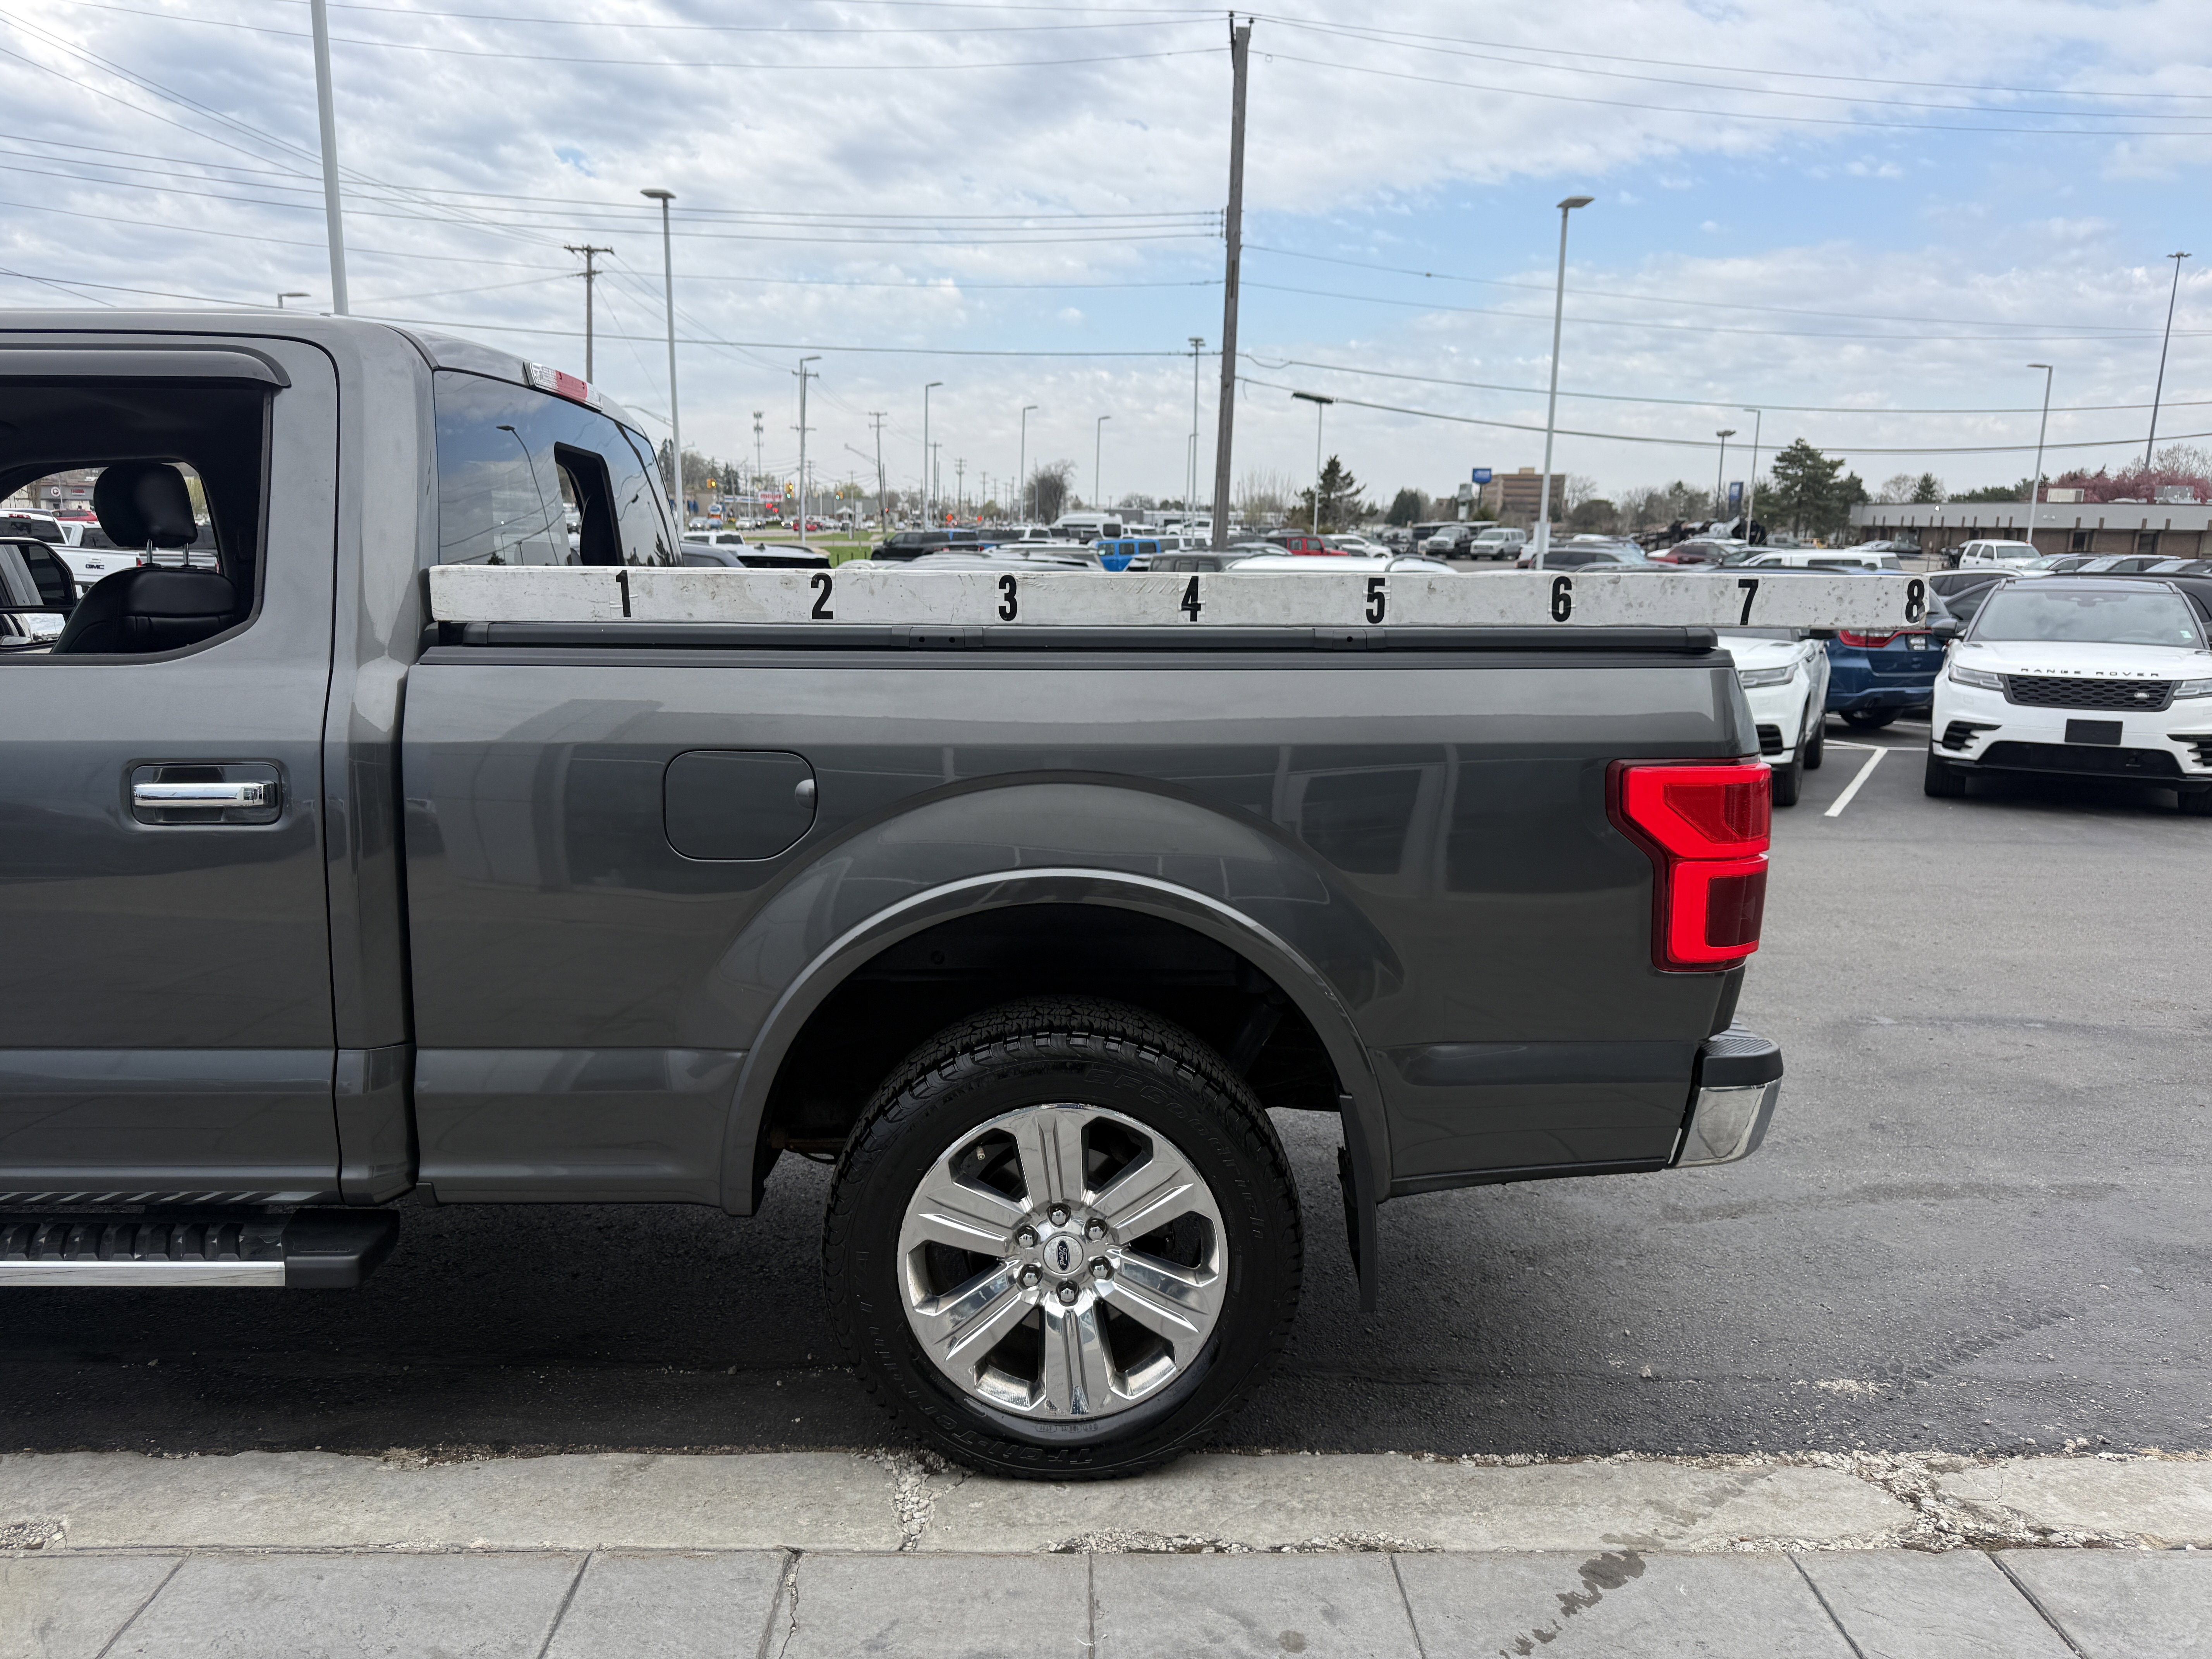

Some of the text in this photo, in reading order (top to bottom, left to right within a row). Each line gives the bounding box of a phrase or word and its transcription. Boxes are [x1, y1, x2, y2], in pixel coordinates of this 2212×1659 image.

[616, 570, 1925, 625] 1 2 3 4 5 6 7 8
[1059, 1245, 1068, 1266] Ford
